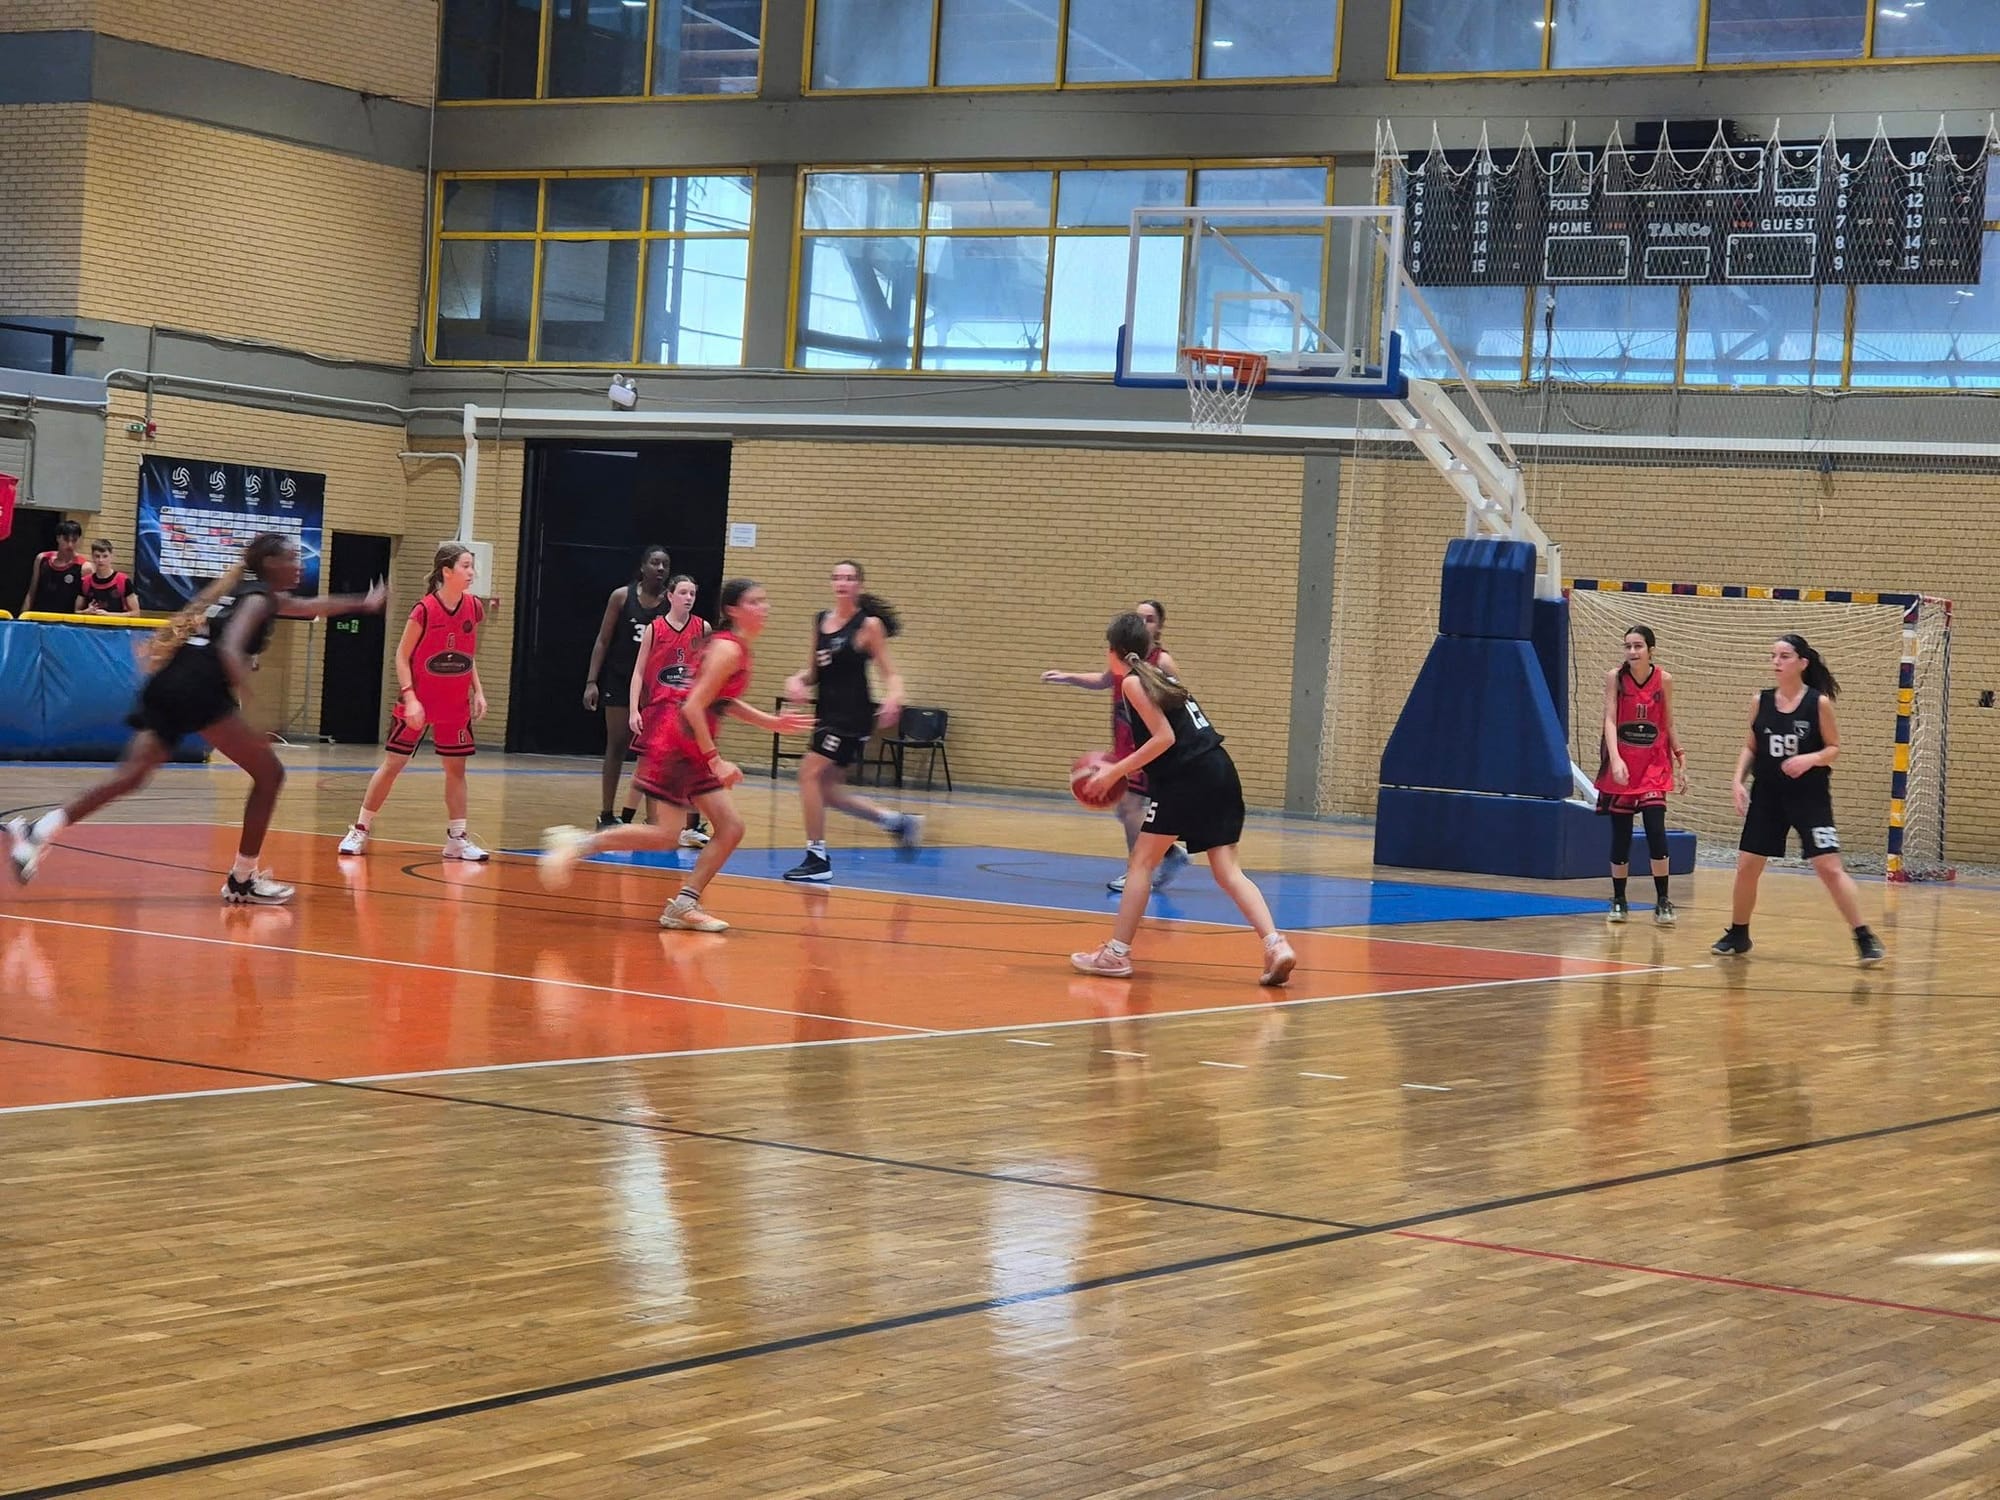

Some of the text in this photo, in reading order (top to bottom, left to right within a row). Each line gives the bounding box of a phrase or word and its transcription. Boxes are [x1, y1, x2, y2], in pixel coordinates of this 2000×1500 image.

[1841, 153, 1850, 167] 4
[1909, 151, 1927, 166] 10
[1477, 162, 1491, 176] 10
[1839, 174, 1849, 188] 5
[1908, 172, 1925, 187] 11
[1415, 182, 1424, 196] 5
[1476, 182, 1488, 195] 11
[1550, 199, 1589, 211] FOULS
[1774, 195, 1817, 207] FOULS
[1837, 194, 1847, 208] 6
[1907, 193, 1924, 207] 12
[1414, 202, 1423, 215] 6
[1475, 201, 1489, 215] 12
[1413, 221, 1422, 234] 7
[1473, 220, 1488, 234] 13
[1548, 221, 1592, 233] HOME
[1761, 218, 1815, 231] GUEST
[1836, 215, 1846, 229] 7
[1906, 214, 1922, 229] 13
[1412, 241, 1421, 254] 8
[1472, 240, 1487, 254] 14
[1835, 235, 1845, 249] 8
[1904, 235, 1921, 249] 14
[1412, 260, 1420, 273] 9
[1471, 259, 1486, 273] 15
[1834, 256, 1843, 270] 9
[1904, 256, 1920, 270] 15
[677, 647, 685, 664] 5
[1769, 734, 1799, 757] 69
